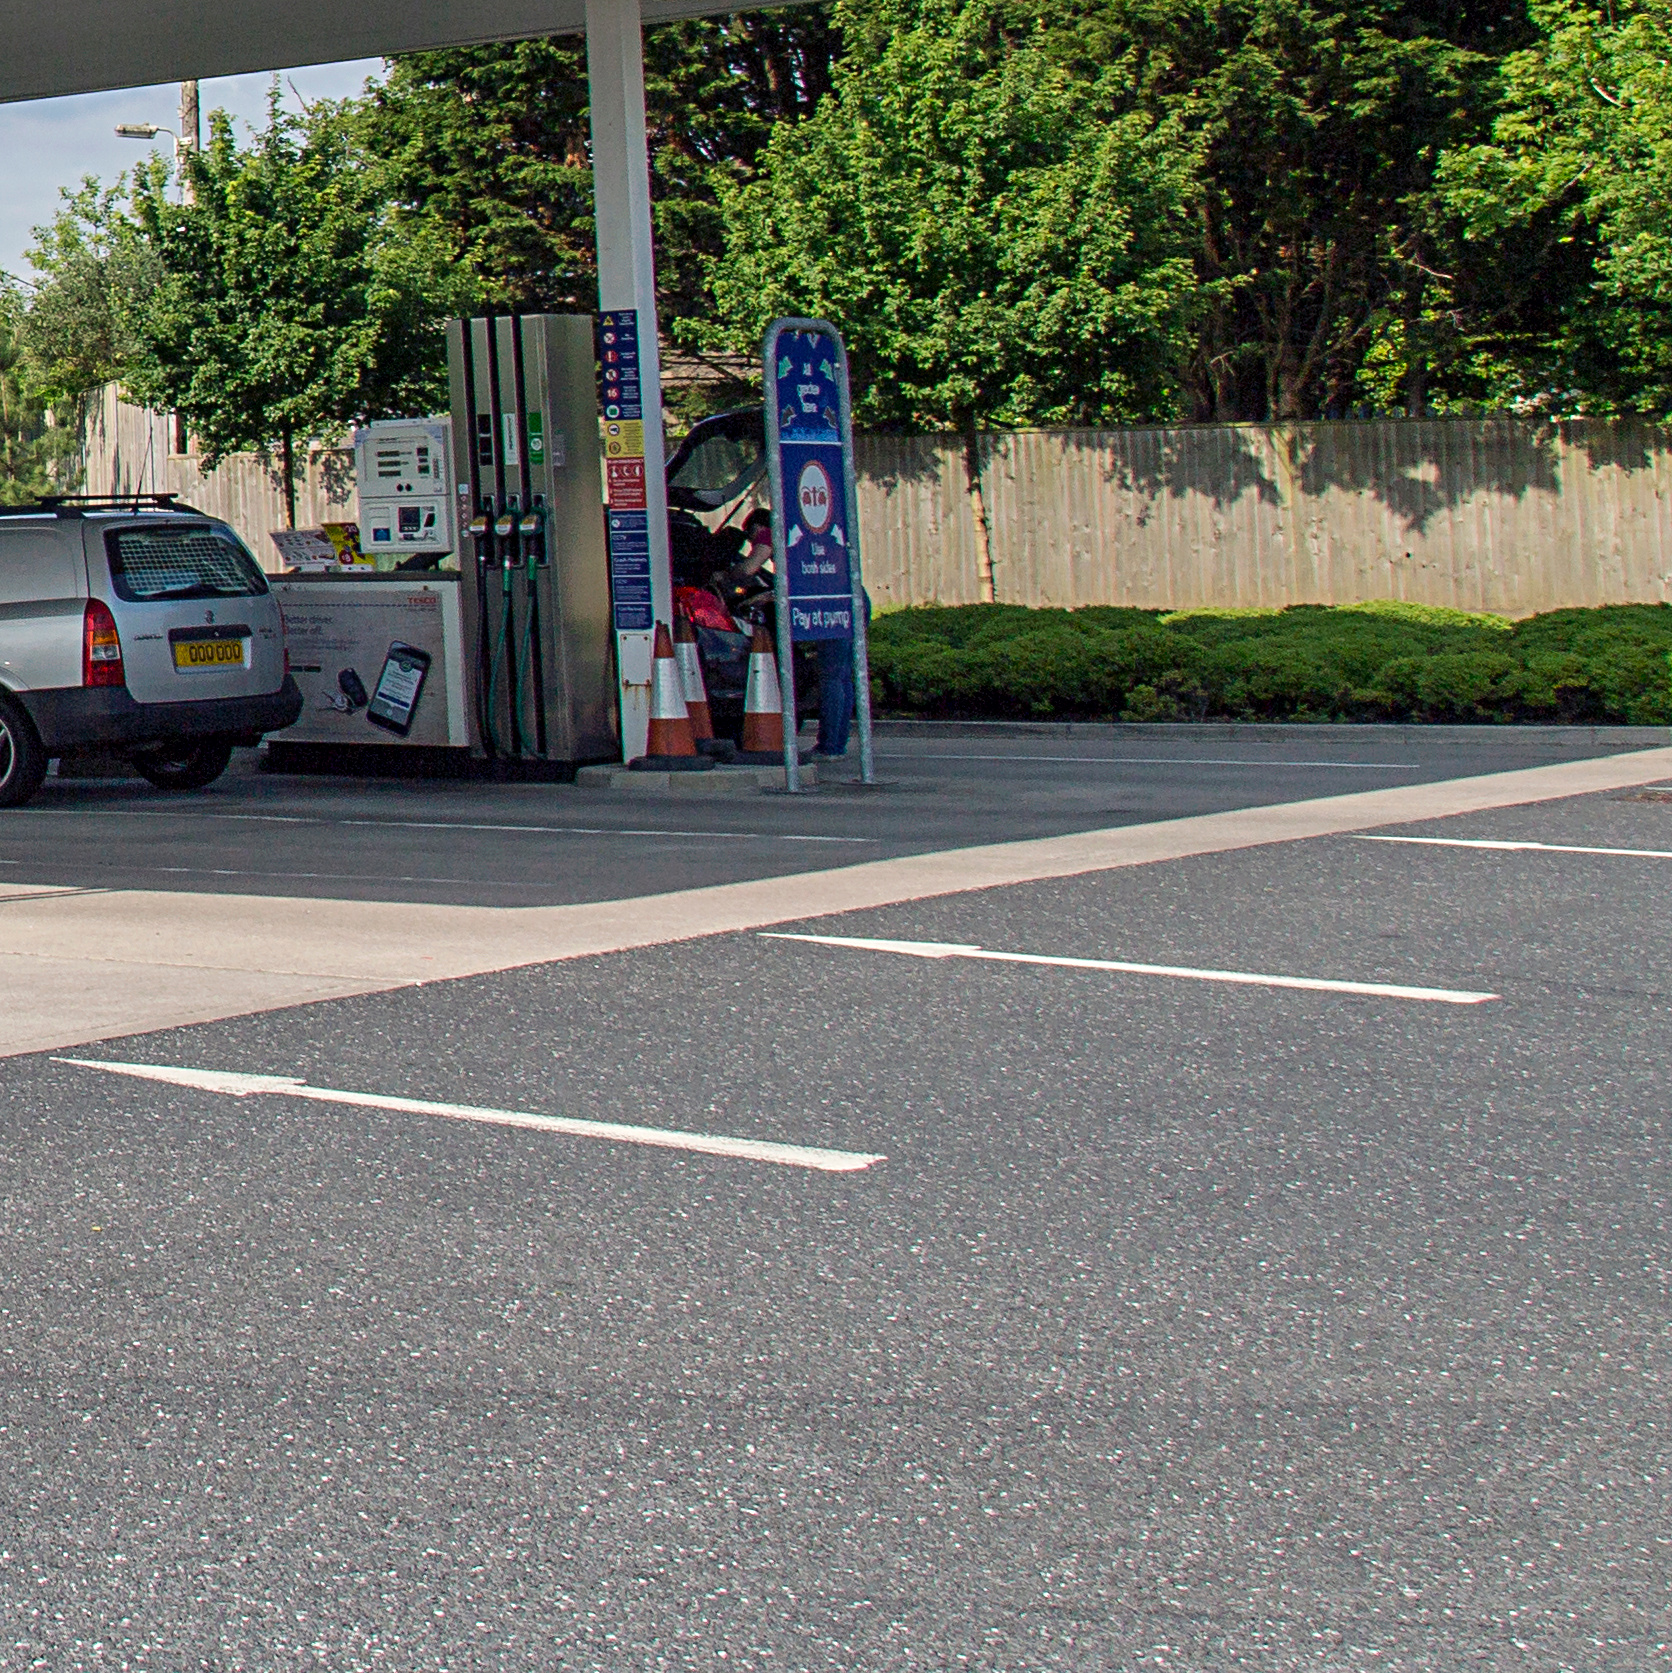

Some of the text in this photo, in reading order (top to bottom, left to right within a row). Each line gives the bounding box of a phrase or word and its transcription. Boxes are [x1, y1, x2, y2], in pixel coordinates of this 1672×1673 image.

[792, 608, 850, 630] Pay at pump
